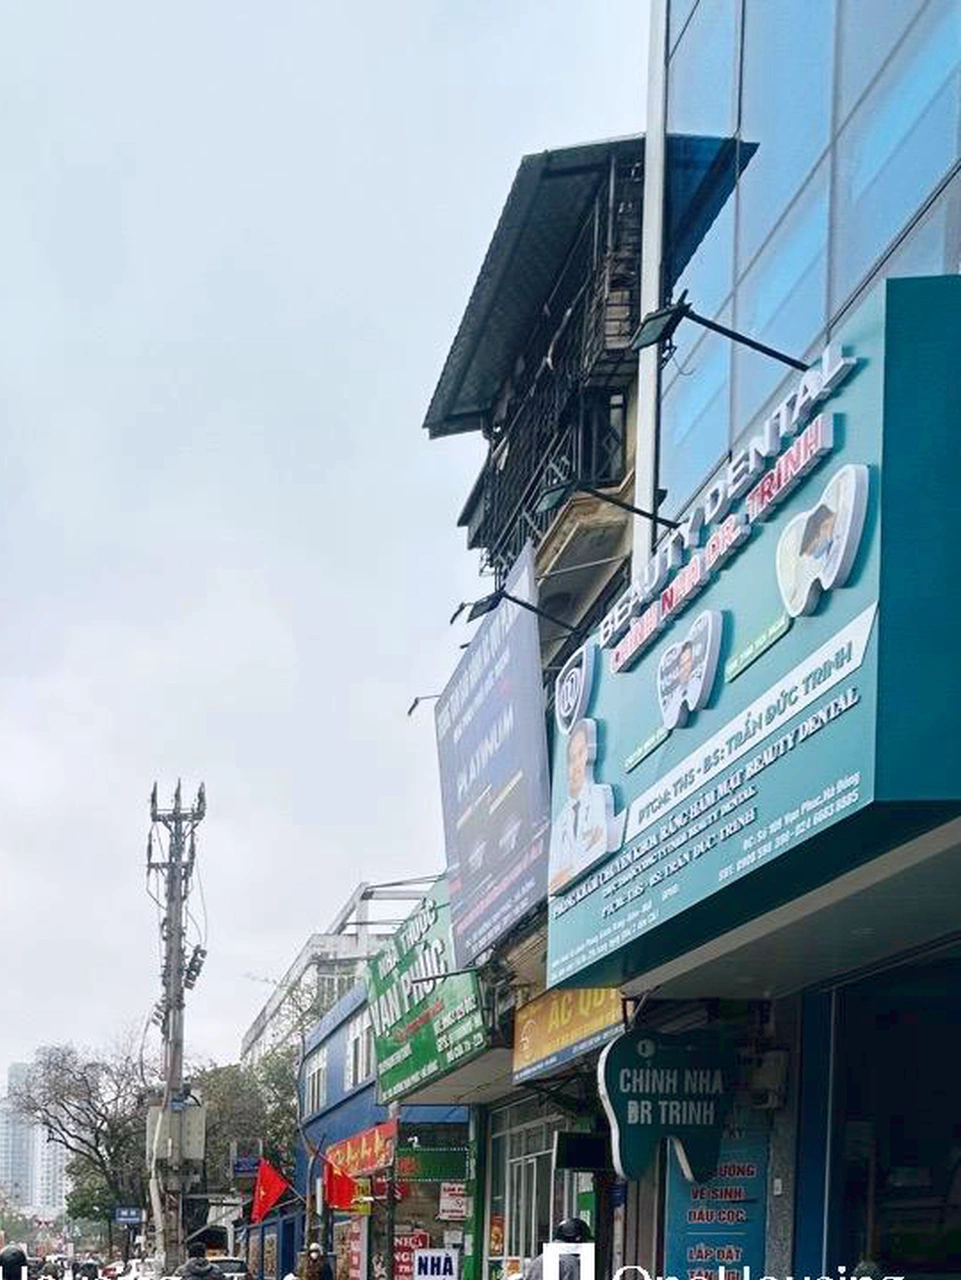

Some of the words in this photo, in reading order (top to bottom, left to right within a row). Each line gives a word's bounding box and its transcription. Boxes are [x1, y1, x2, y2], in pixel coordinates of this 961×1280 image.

[600, 507, 704, 649] BEAUTY
[704, 344, 857, 526] DENTAL
[797, 684, 860, 746] DENTAL
[684, 1069, 724, 1095] NHA
[658, 1100, 715, 1125] TRINH
[417, 1253, 454, 1276] NHÀ
